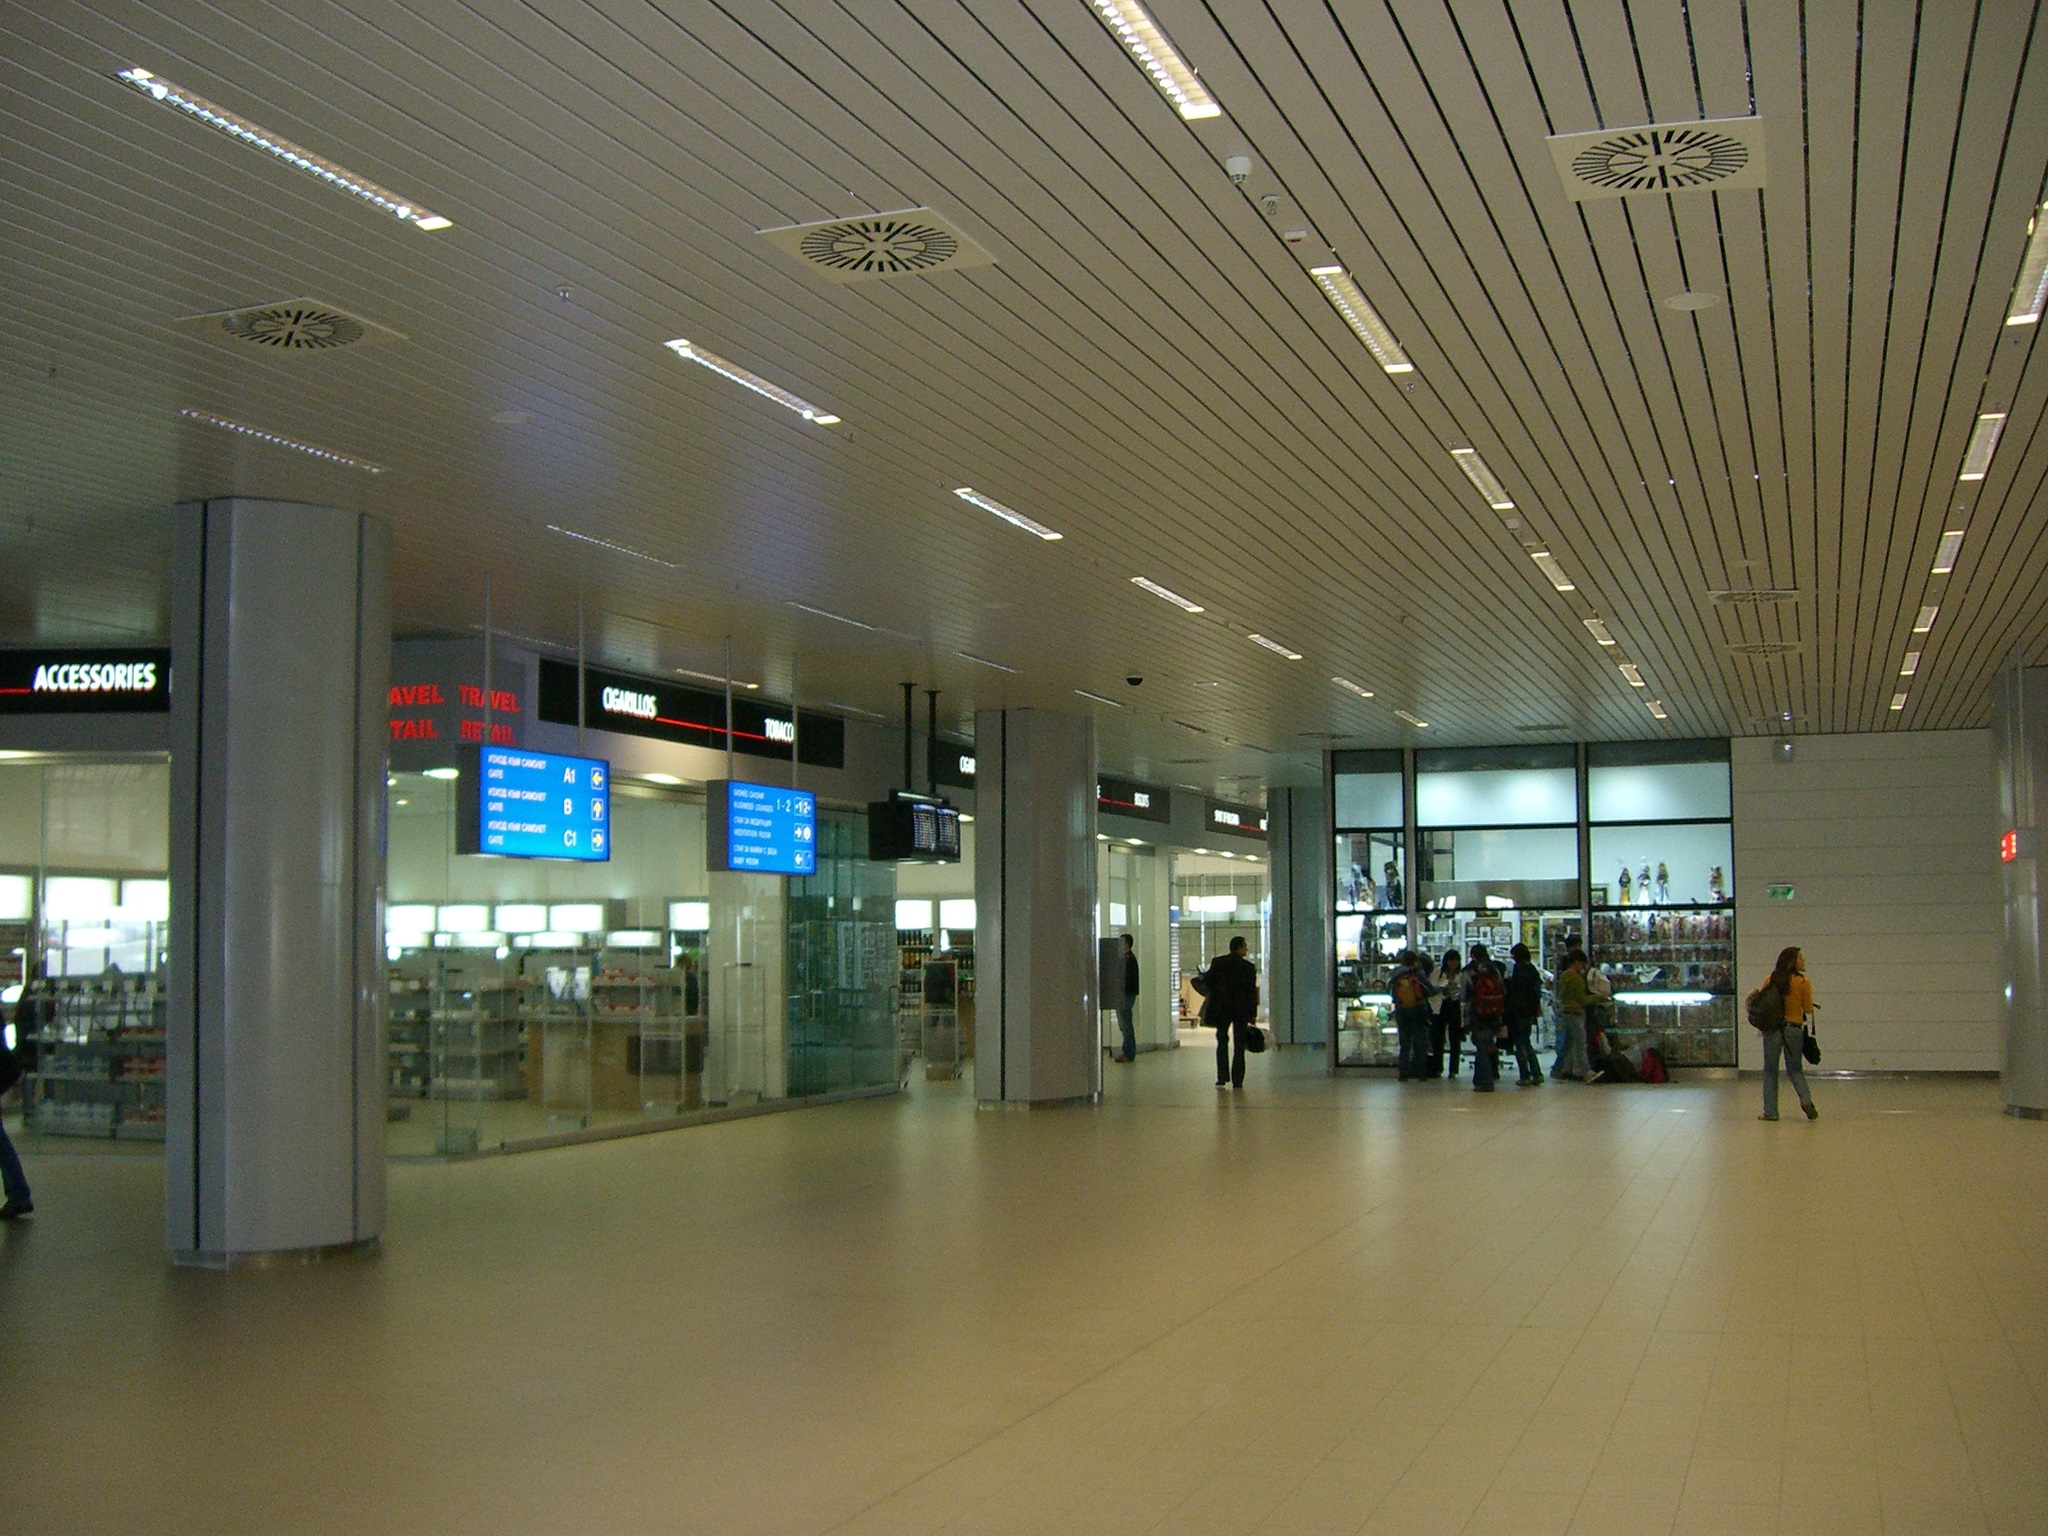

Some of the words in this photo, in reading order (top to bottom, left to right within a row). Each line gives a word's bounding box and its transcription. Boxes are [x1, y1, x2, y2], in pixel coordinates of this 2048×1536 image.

[34, 663, 156, 692] ACCESSORIES
[602, 686, 657, 720] CIGARILLOS
[563, 767, 576, 784] A1
[563, 798, 572, 815] B
[563, 829, 577, 847] C1
